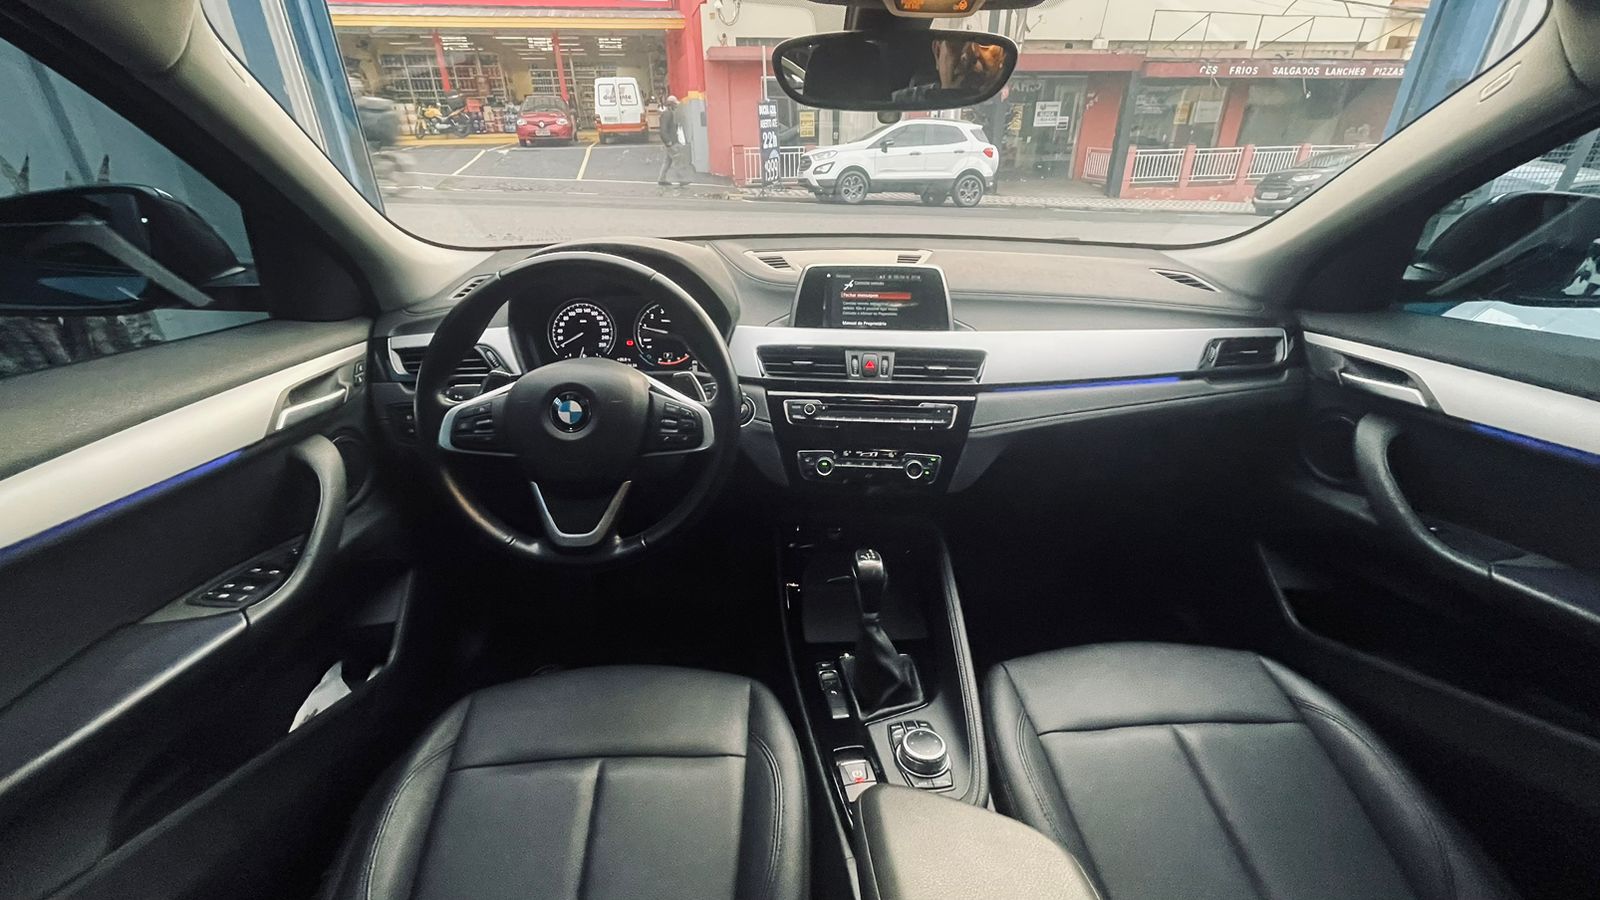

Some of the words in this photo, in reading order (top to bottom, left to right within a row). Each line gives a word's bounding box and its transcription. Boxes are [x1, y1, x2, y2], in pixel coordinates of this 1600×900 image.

[1229, 66, 1259, 75] FRIOS
[1272, 66, 1320, 76] SALGADOS
[1325, 67, 1367, 76] LANCHES
[1373, 67, 1405, 76] PIZZAS
[762, 131, 778, 149] 22h
